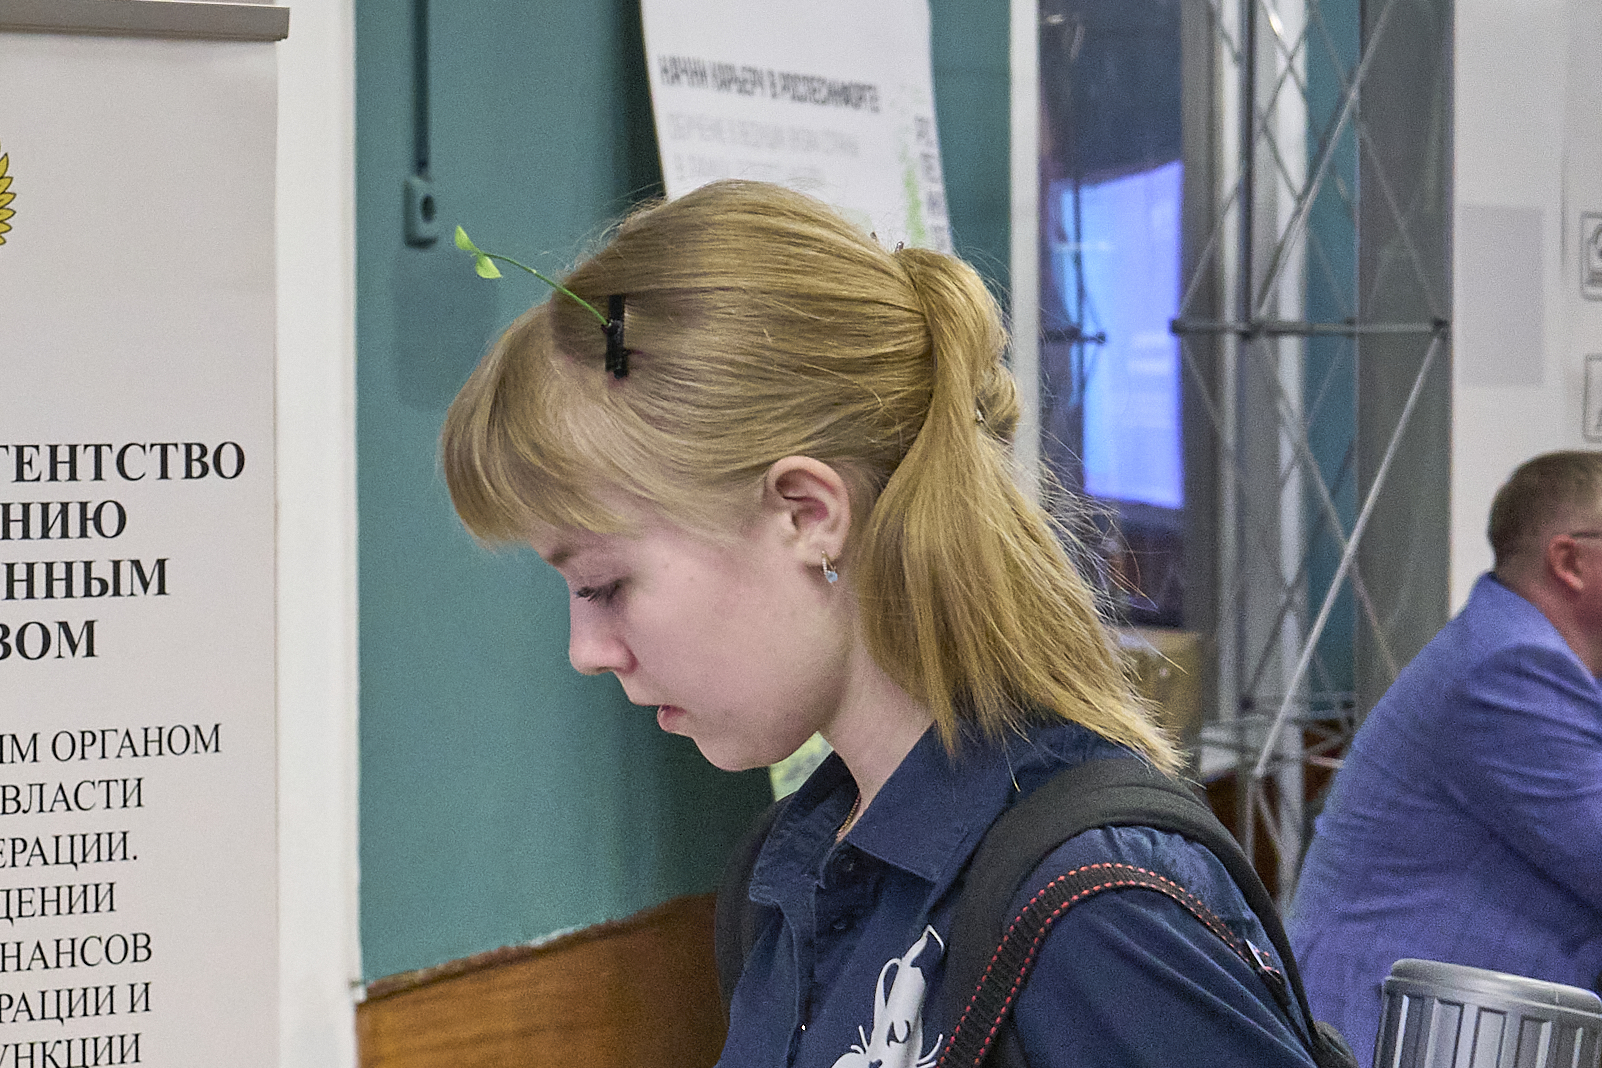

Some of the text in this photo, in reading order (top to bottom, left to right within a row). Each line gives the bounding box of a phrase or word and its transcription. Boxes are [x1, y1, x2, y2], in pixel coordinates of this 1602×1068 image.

[51, 723, 224, 765] ОРГАНОМ
[0, 777, 146, 816] ВЛАСТИ
[127, 982, 152, 1014] И
